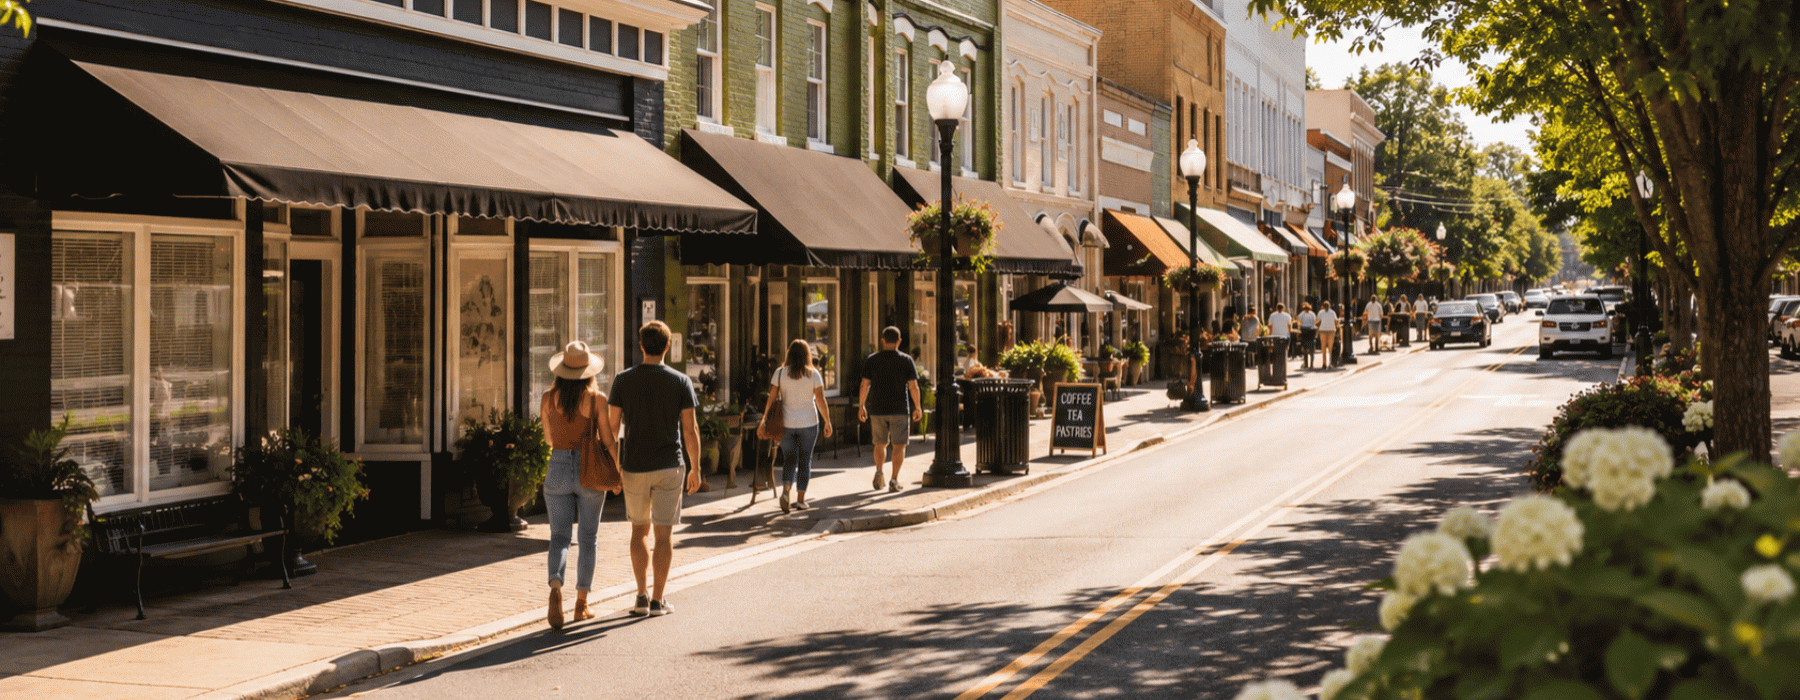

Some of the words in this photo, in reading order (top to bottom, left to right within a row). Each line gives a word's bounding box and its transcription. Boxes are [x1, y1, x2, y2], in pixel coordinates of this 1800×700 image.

[1061, 392, 1092, 405] COFFEE
[1067, 409, 1083, 421] TEA
[1056, 425, 1092, 438] PASTRIES
